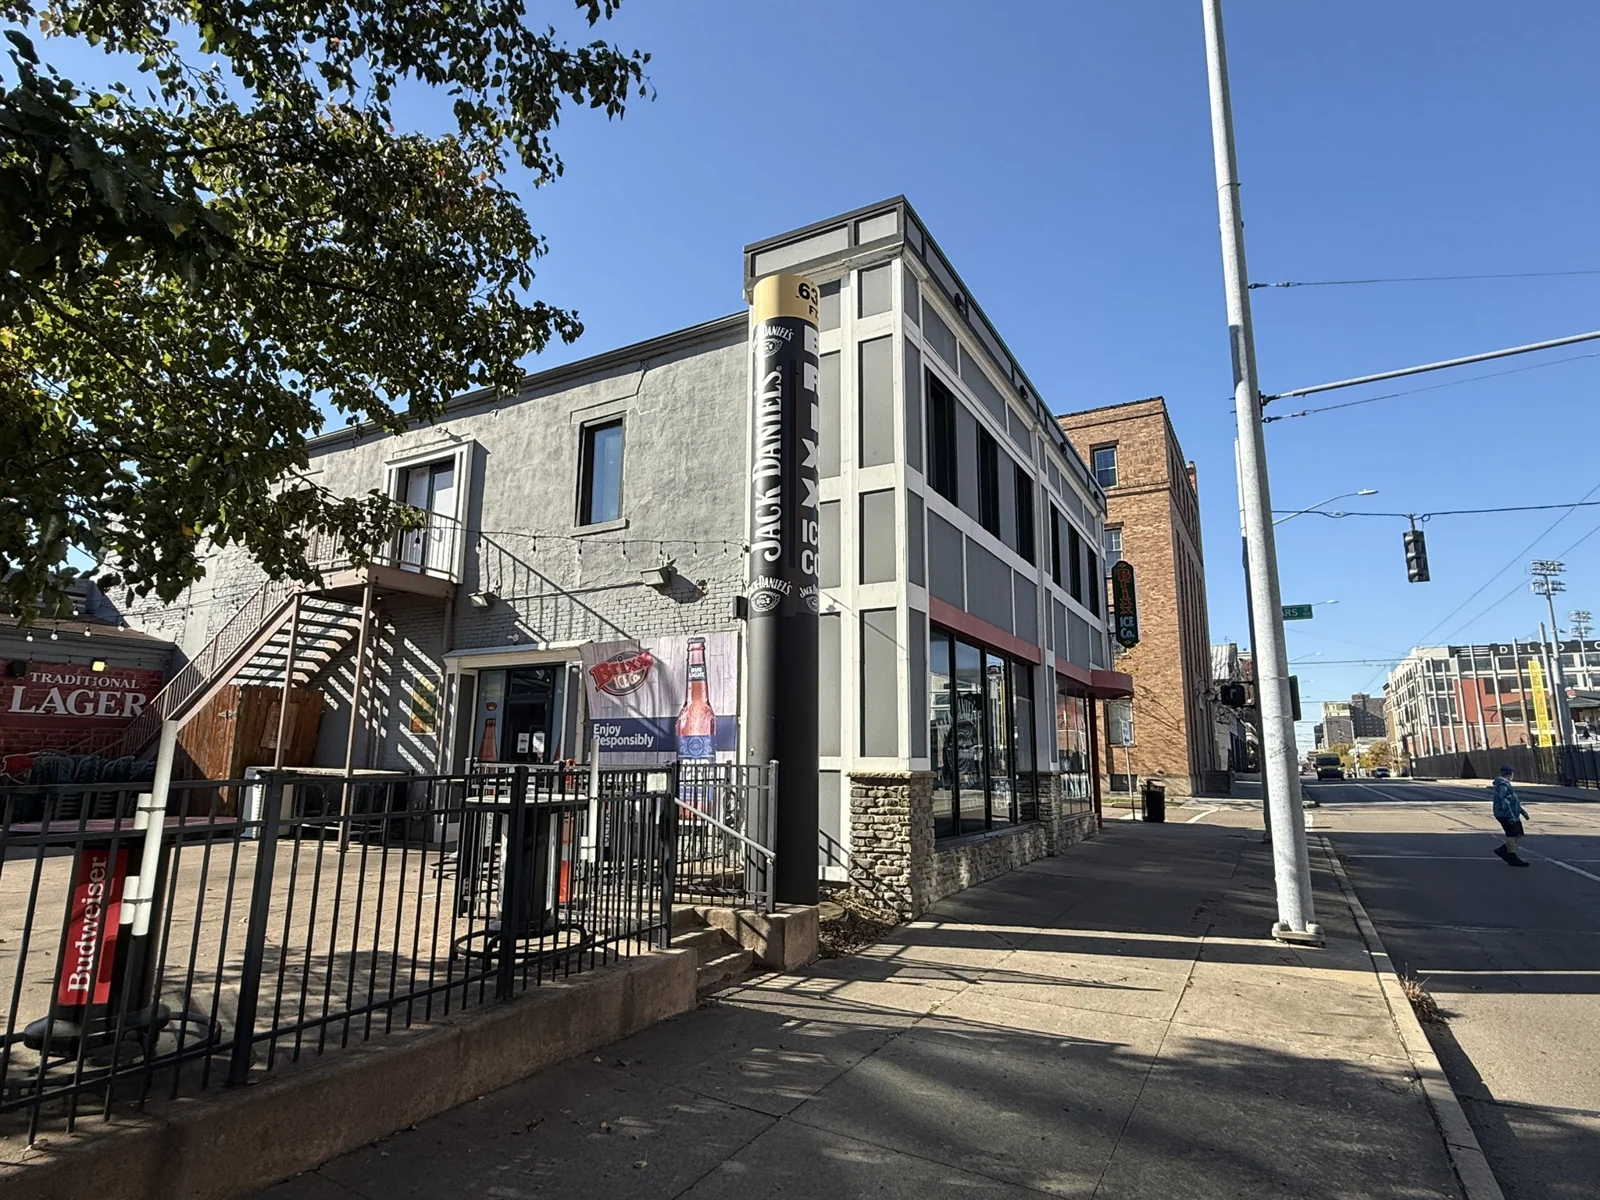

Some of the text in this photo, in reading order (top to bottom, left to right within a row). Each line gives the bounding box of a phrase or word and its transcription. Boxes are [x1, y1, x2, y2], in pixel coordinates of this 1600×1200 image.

[751, 370, 782, 562] JACK DANIEL'S
[801, 518, 819, 546] IC
[758, 574, 793, 597] DANIEL'S
[1120, 616, 1135, 628] ICE
[1500, 642, 1565, 654] DELO
[29, 671, 140, 689] TRADITIONAL
[8, 685, 147, 718] LAGER
[593, 722, 621, 737] Enjoy
[593, 733, 654, 748] Responsibly
[67, 856, 108, 993] Budweiser
